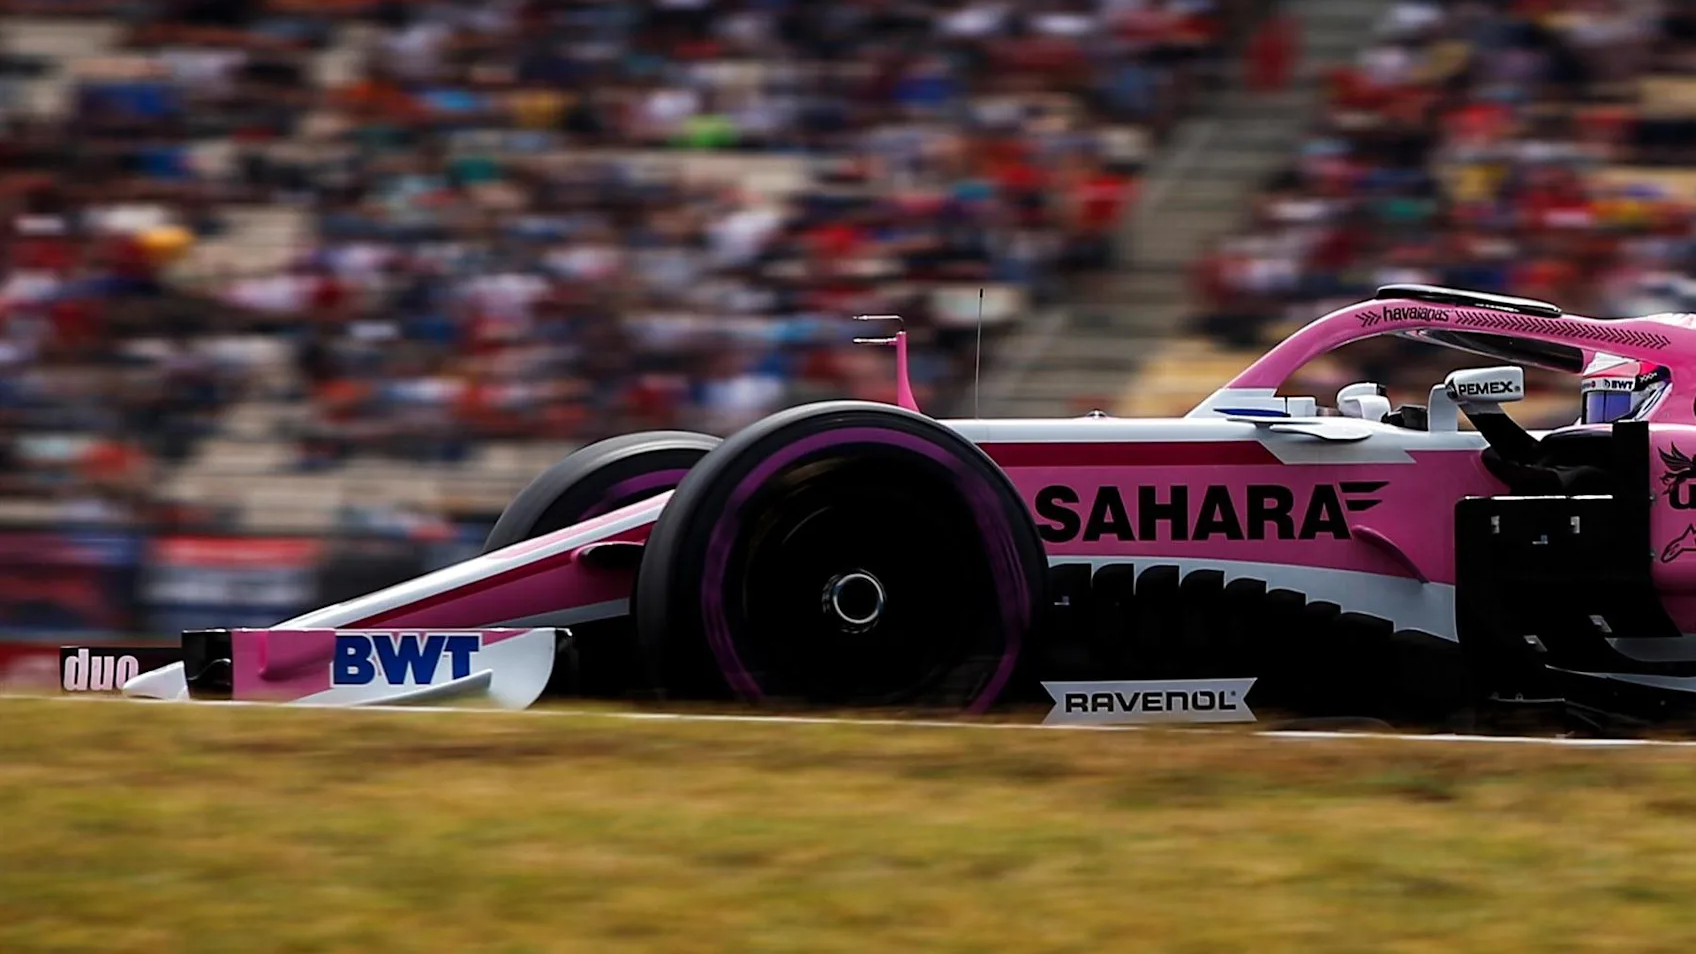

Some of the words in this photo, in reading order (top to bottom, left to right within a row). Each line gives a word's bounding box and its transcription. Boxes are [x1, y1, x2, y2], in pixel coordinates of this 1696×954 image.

[1382, 306, 1449, 322] havaianas
[1458, 380, 1514, 395] PEMEX
[1034, 484, 1352, 543] SAHARA
[63, 648, 139, 691] duo
[332, 635, 480, 686] BWT
[1065, 691, 1237, 713] RAVENOL
